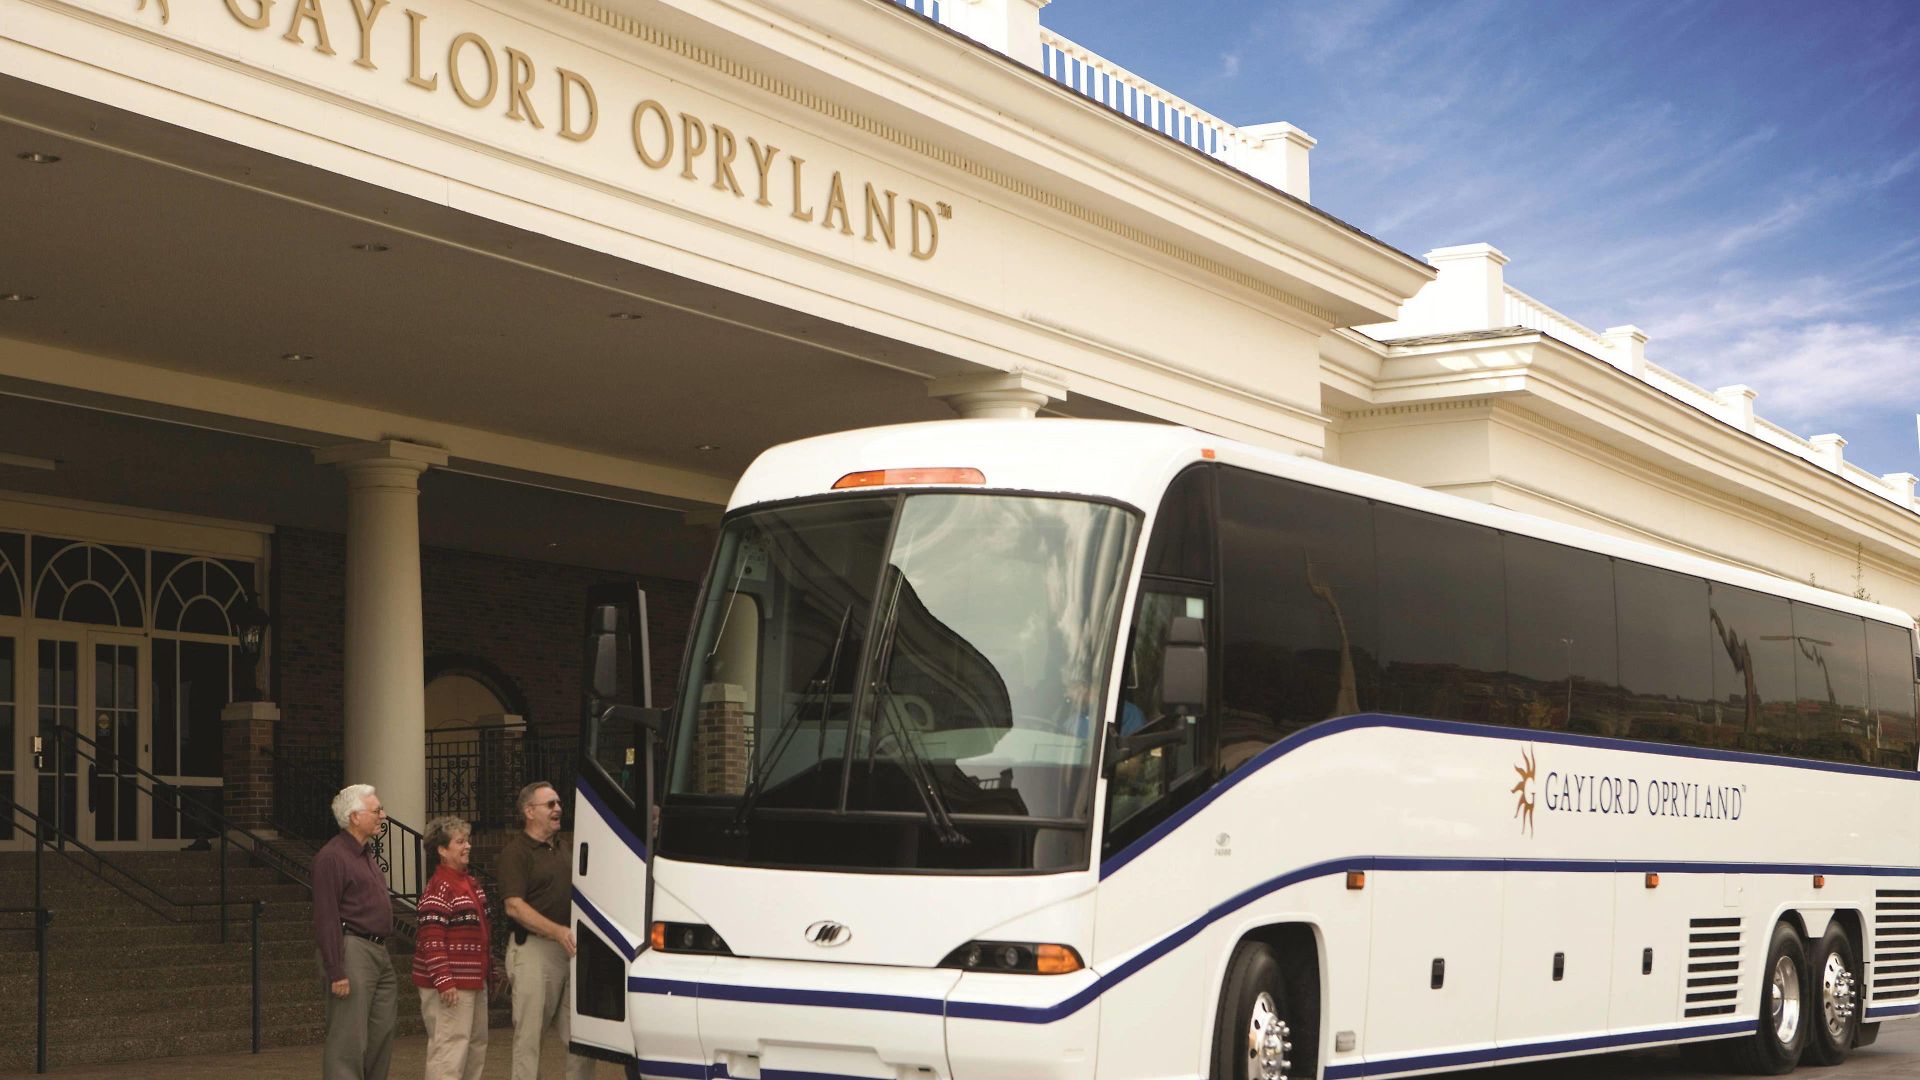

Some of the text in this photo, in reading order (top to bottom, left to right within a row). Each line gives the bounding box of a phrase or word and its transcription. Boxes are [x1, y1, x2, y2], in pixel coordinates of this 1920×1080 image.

[632, 99, 939, 261] OPRYLAND
[1545, 771, 1742, 821] GAYLORD OPRYLAND
